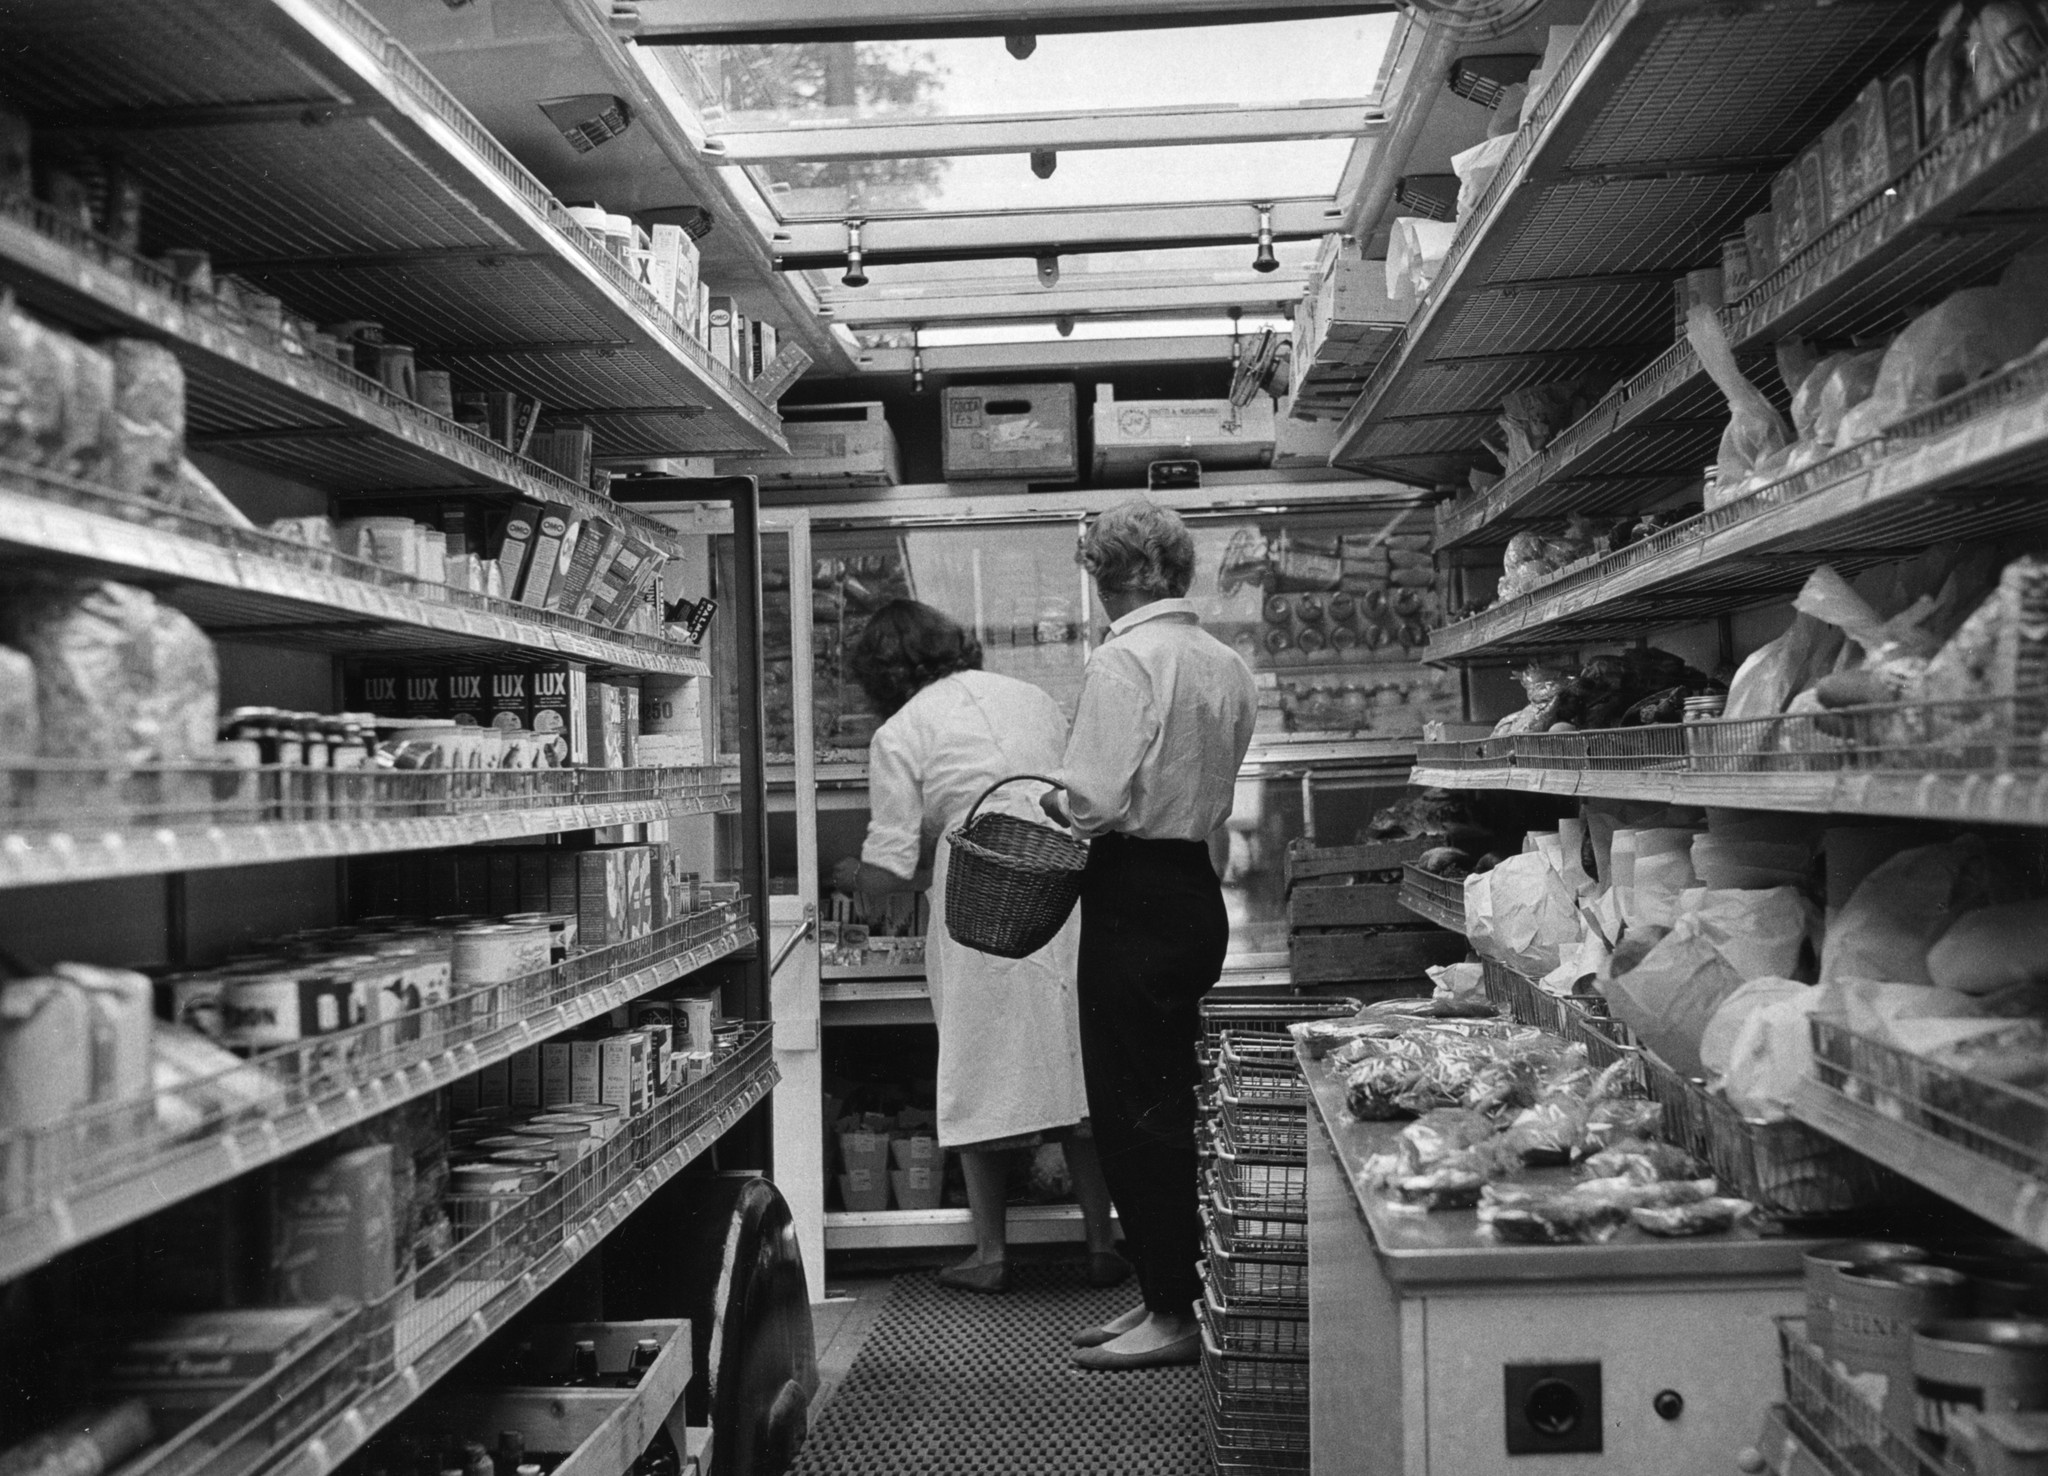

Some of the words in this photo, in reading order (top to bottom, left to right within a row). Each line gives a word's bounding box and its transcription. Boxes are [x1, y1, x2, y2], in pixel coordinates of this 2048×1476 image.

[711, 313, 728, 322] OMO
[509, 523, 529, 535] OMO
[543, 521, 564, 532] OMO
[691, 603, 714, 640] PALMO
[364, 678, 397, 701] LUX
[407, 678, 439, 701] LUX
[449, 675, 482, 699] LUX
[492, 674, 525, 698] LUX
[534, 672, 567, 696] LUX
